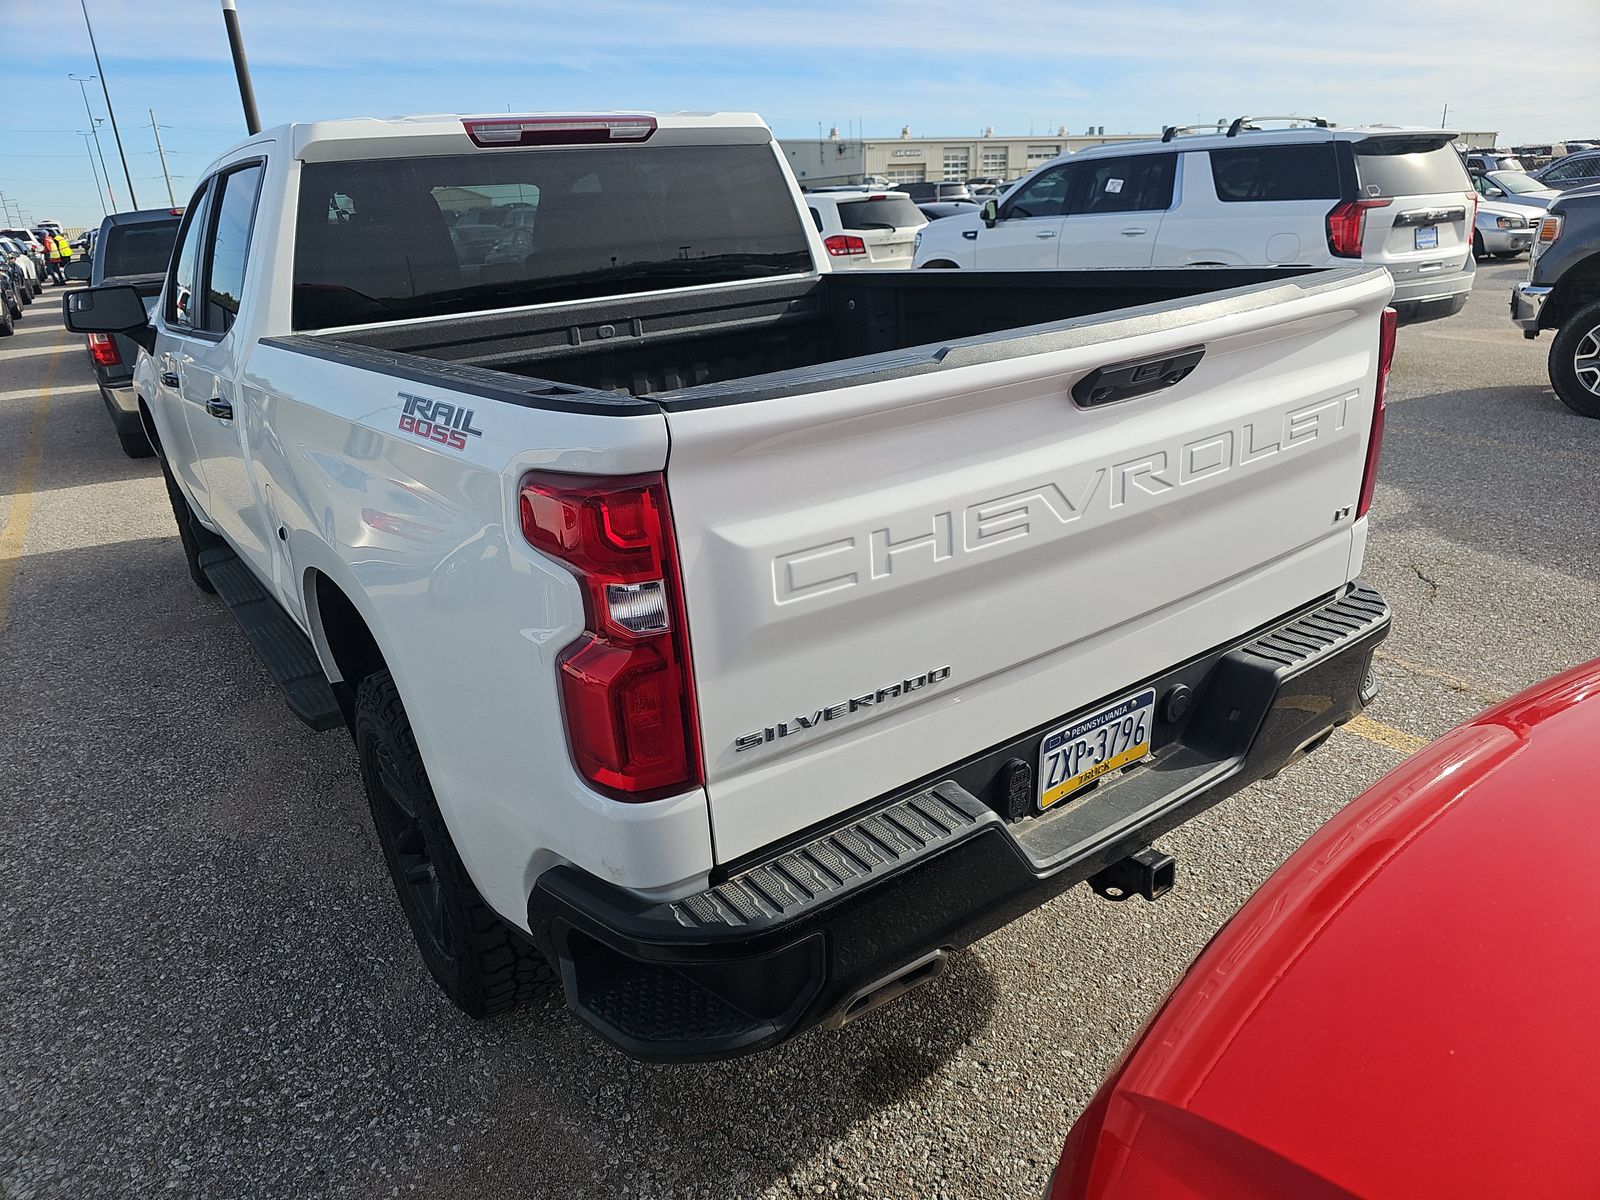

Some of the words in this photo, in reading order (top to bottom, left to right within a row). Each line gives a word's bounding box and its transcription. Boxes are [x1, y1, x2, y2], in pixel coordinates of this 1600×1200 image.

[397, 391, 483, 437] TRAIL
[399, 413, 467, 450] BOSS
[772, 388, 1360, 605] CHEVROLET
[735, 664, 951, 752] SILVERADO
[1071, 705, 1128, 738] PENNSYLVANIA
[1078, 762, 1111, 784] TRUCK
